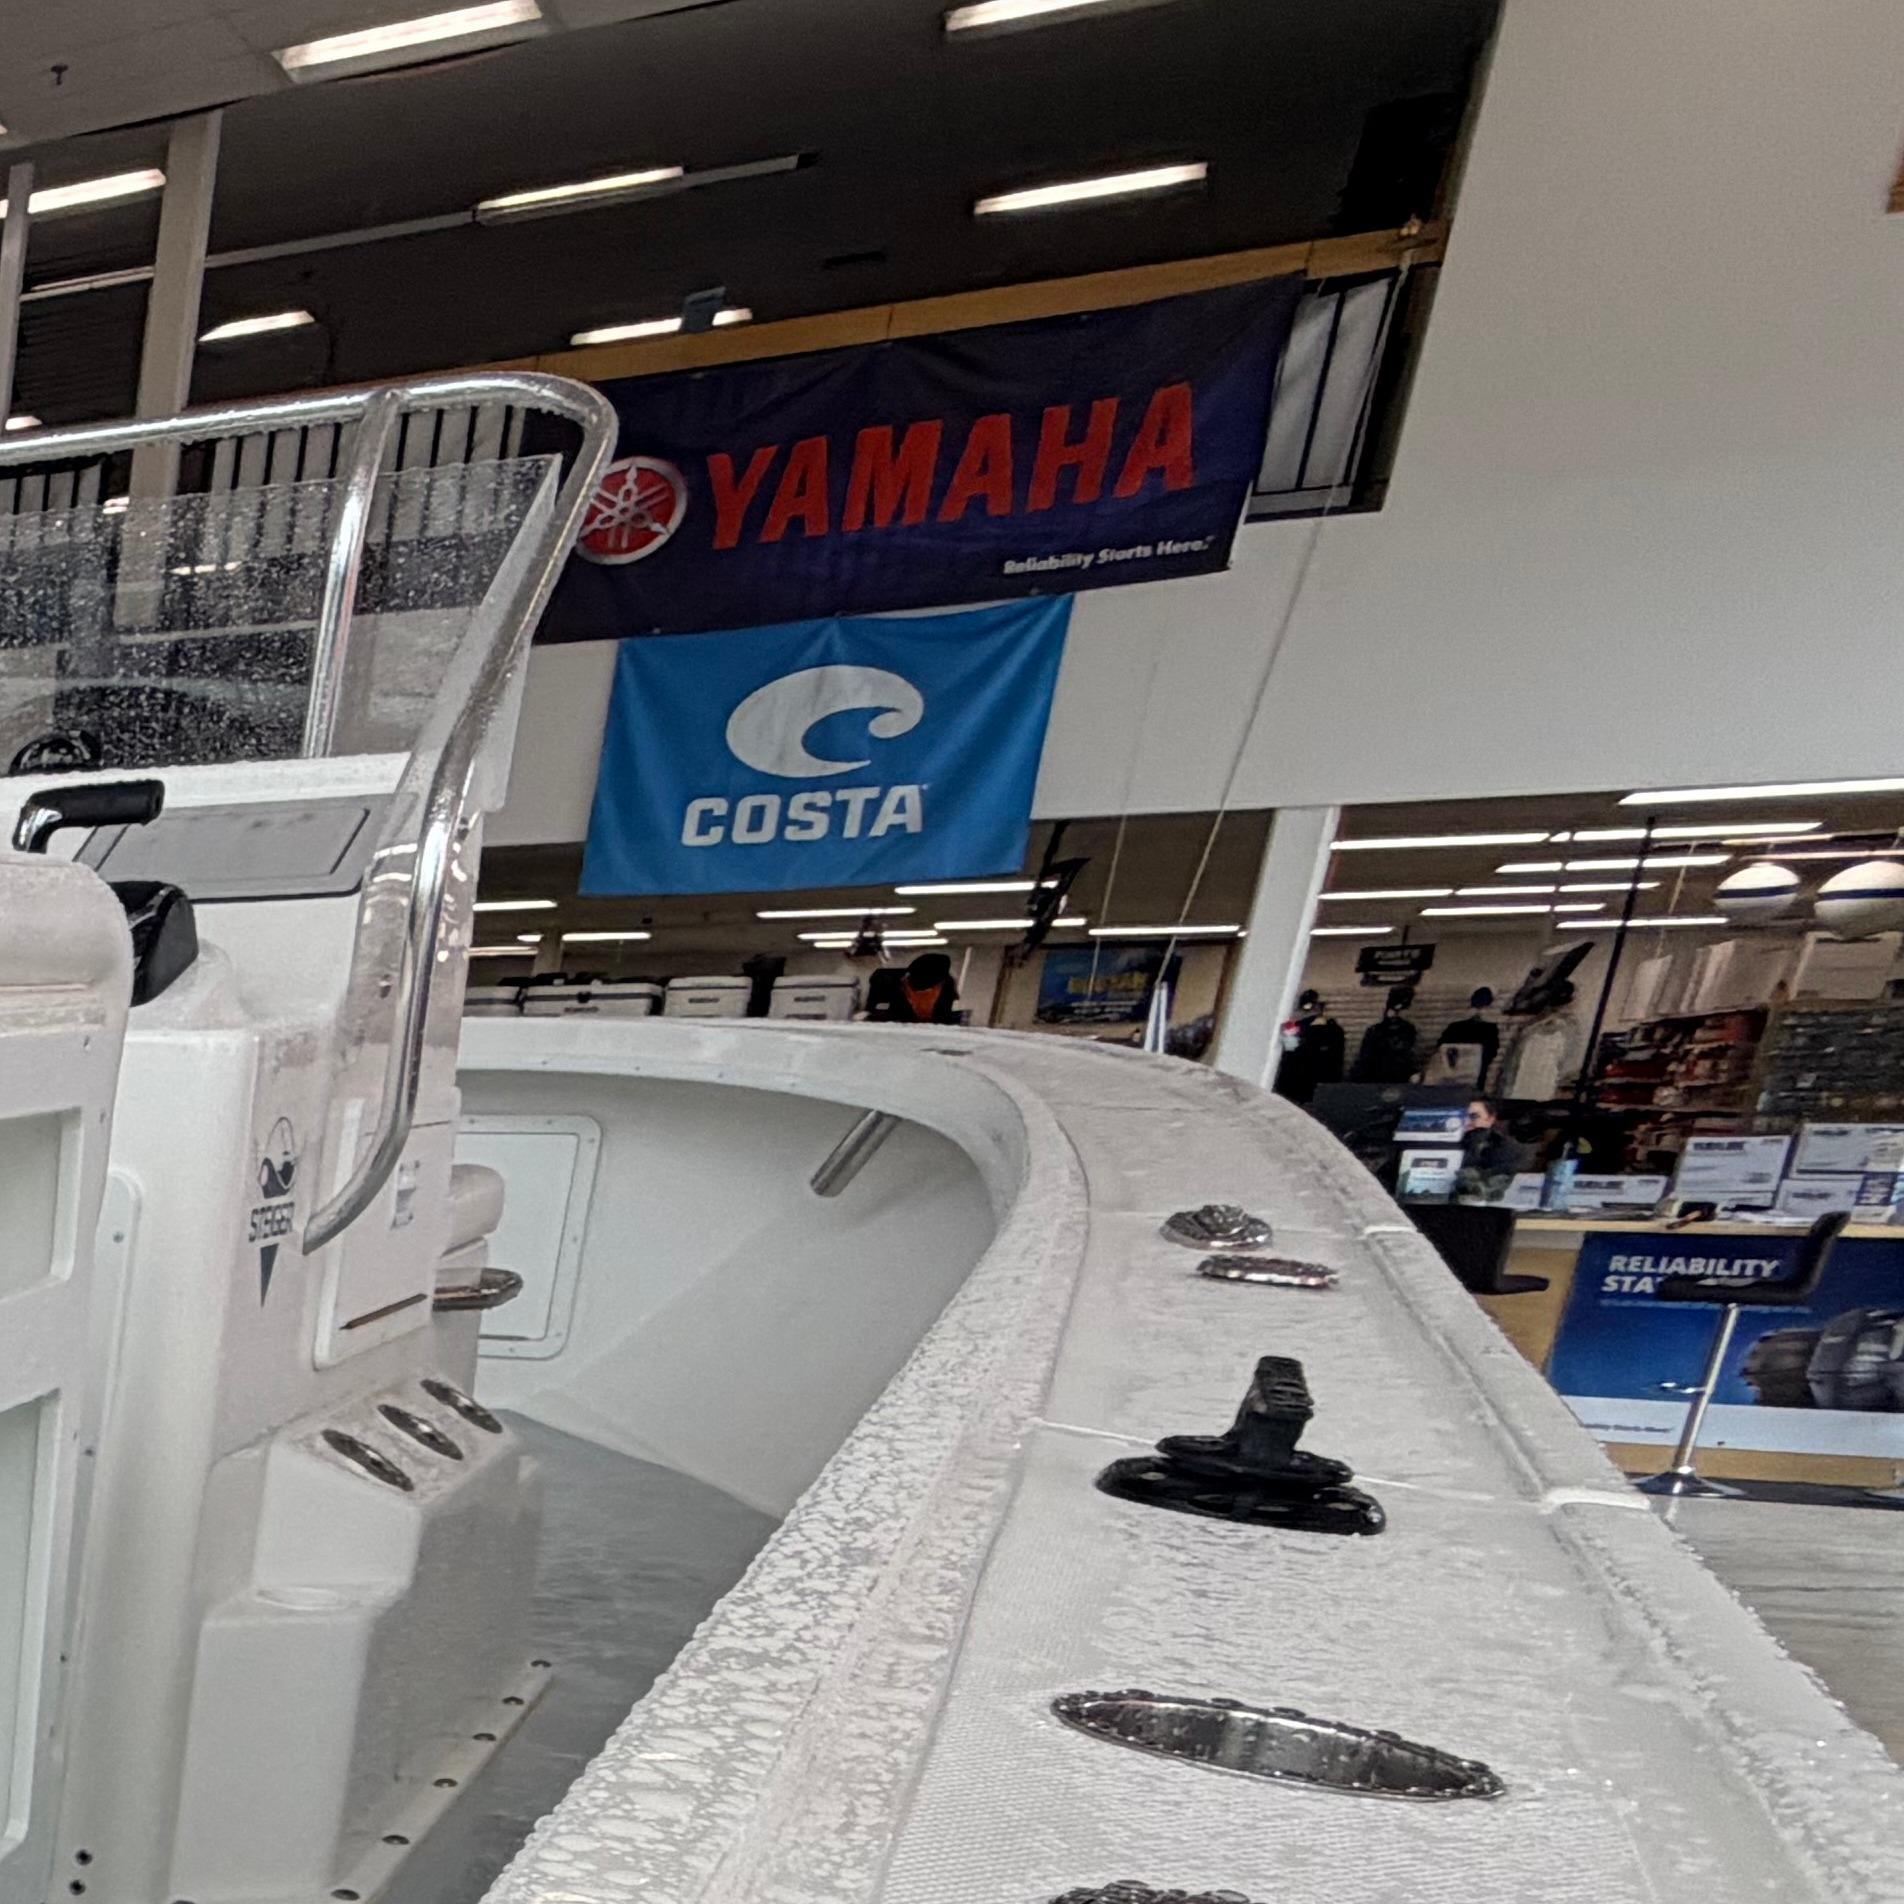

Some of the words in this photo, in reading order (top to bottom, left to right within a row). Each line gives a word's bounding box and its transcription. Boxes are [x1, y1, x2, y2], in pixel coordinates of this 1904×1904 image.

[706, 381, 1196, 550] YAMAHA
[1003, 553, 1095, 574] Reliability
[1097, 544, 1153, 565] Starts
[681, 784, 923, 847] COSTA
[1608, 1254, 1781, 1278] RELIABILITY
[1600, 1275, 1664, 1294] STA
